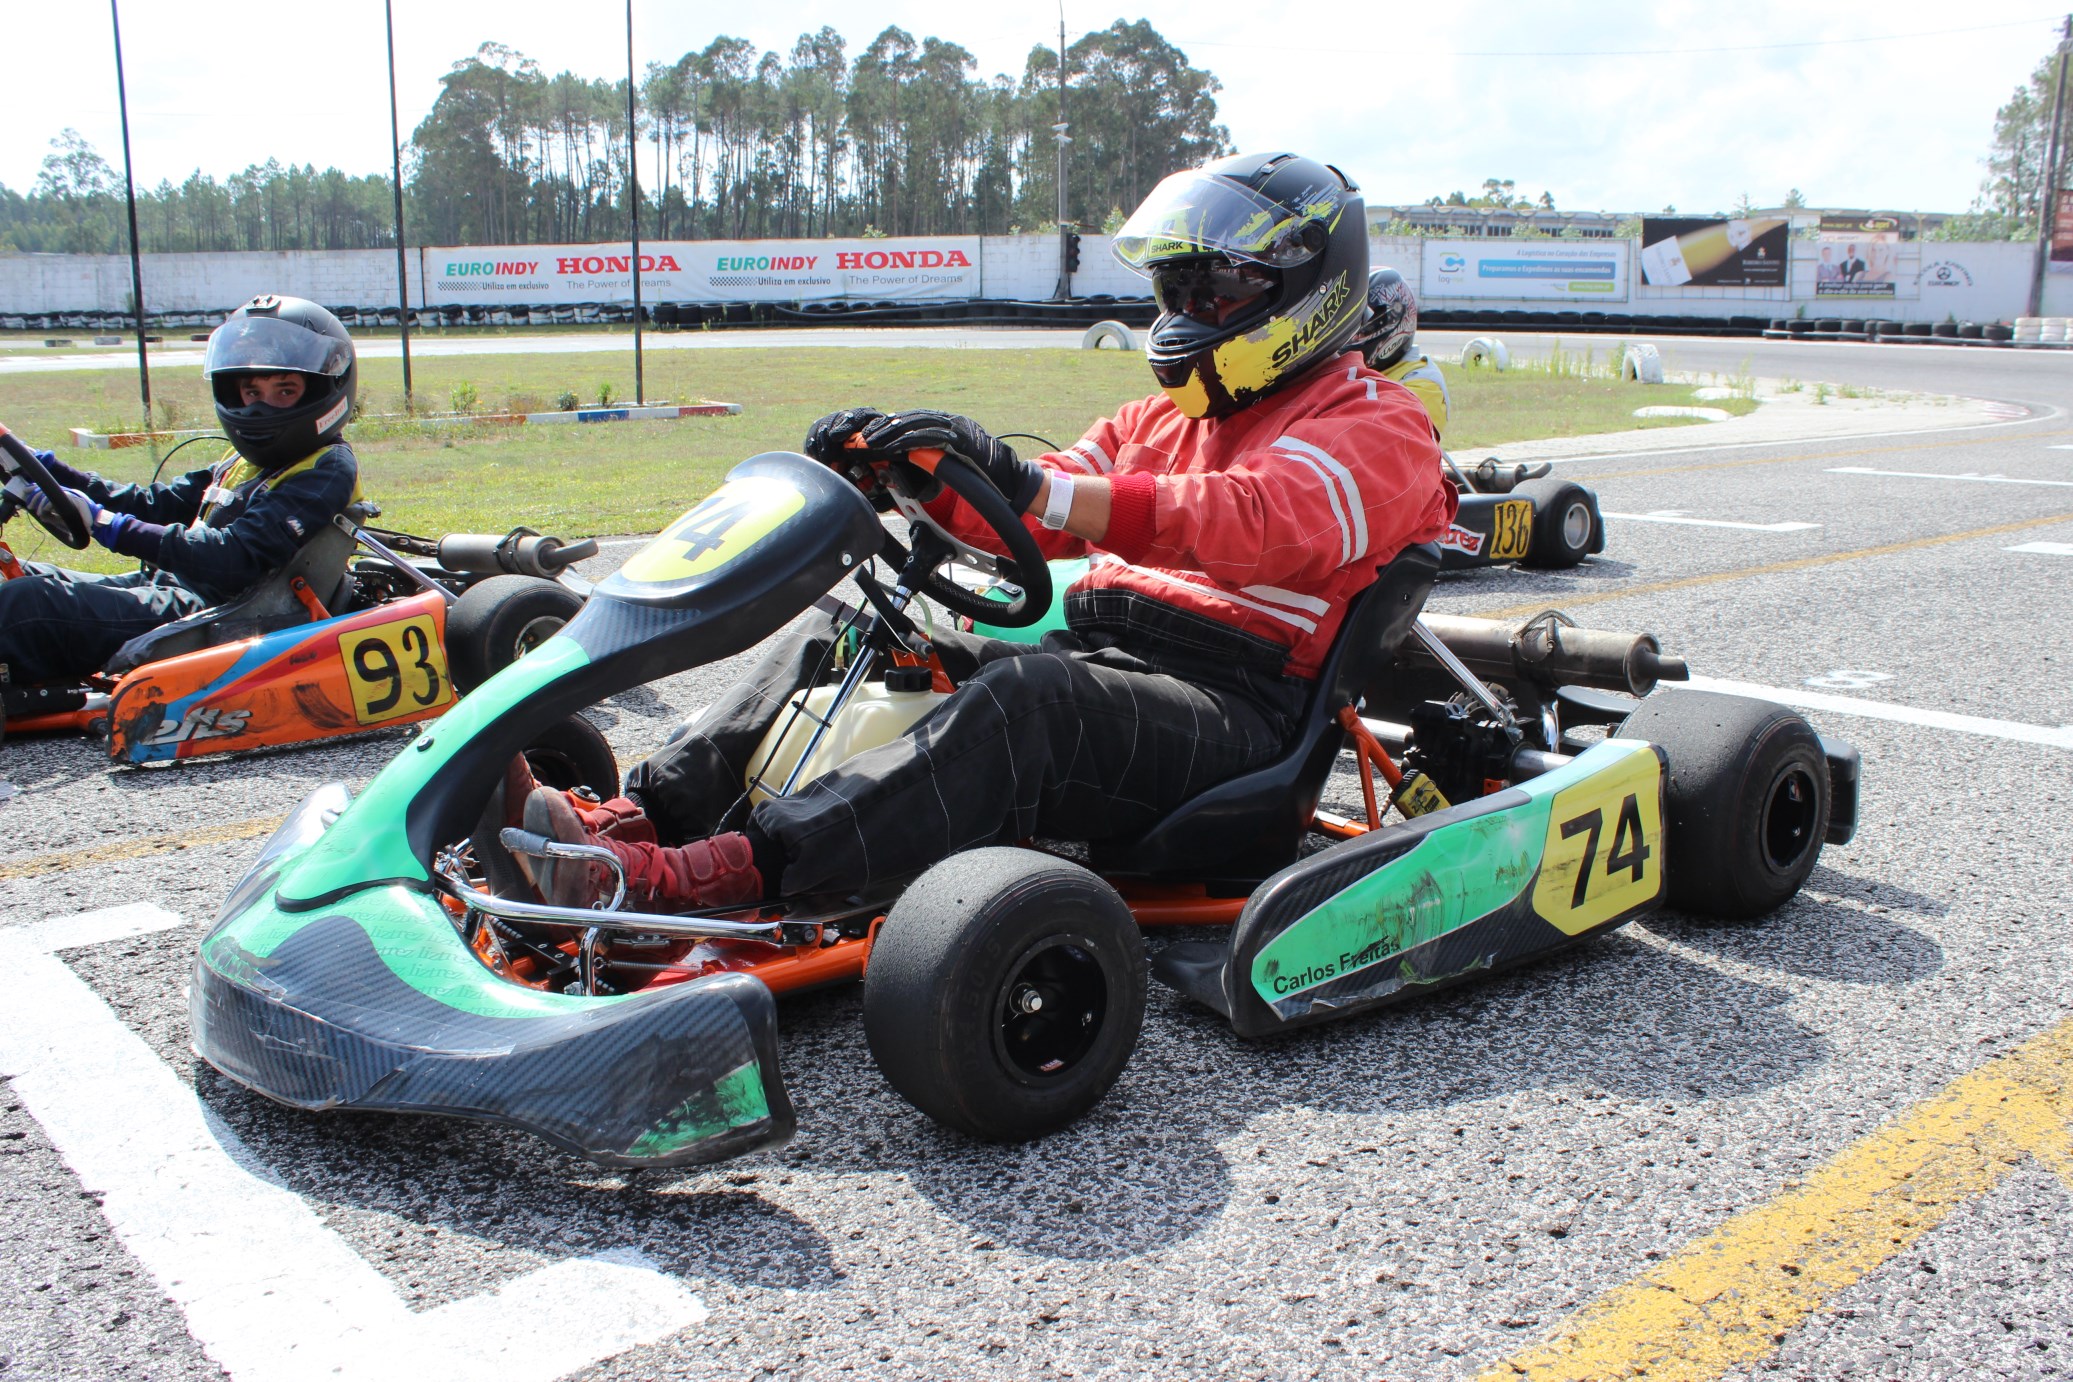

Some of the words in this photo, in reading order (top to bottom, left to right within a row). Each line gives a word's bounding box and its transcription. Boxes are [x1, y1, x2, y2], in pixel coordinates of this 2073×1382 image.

[1151, 242, 1183, 254] SHARK
[446, 261, 539, 276] EUROINDY
[556, 255, 681, 274] HONDA
[716, 256, 819, 271] EUROINDY
[836, 250, 972, 270] HONDA
[482, 281, 505, 291] Utiliza
[518, 281, 549, 290] exclusivo
[566, 281, 585, 290] The
[587, 280, 618, 290] Power
[620, 279, 630, 288] of
[639, 279, 671, 289] reams
[758, 276, 782, 286] Utiliza
[784, 278, 796, 286] em
[798, 276, 831, 286] exclusivo
[850, 275, 868, 285] The
[871, 274, 905, 285] Power
[908, 273, 918, 283] of
[921, 273, 963, 284] Dreams
[1272, 270, 1350, 369] SHARK
[1492, 504, 1529, 555] 136
[354, 626, 440, 715] 93
[1560, 793, 1650, 910] 74
[1273, 963, 1335, 994] Carlos
